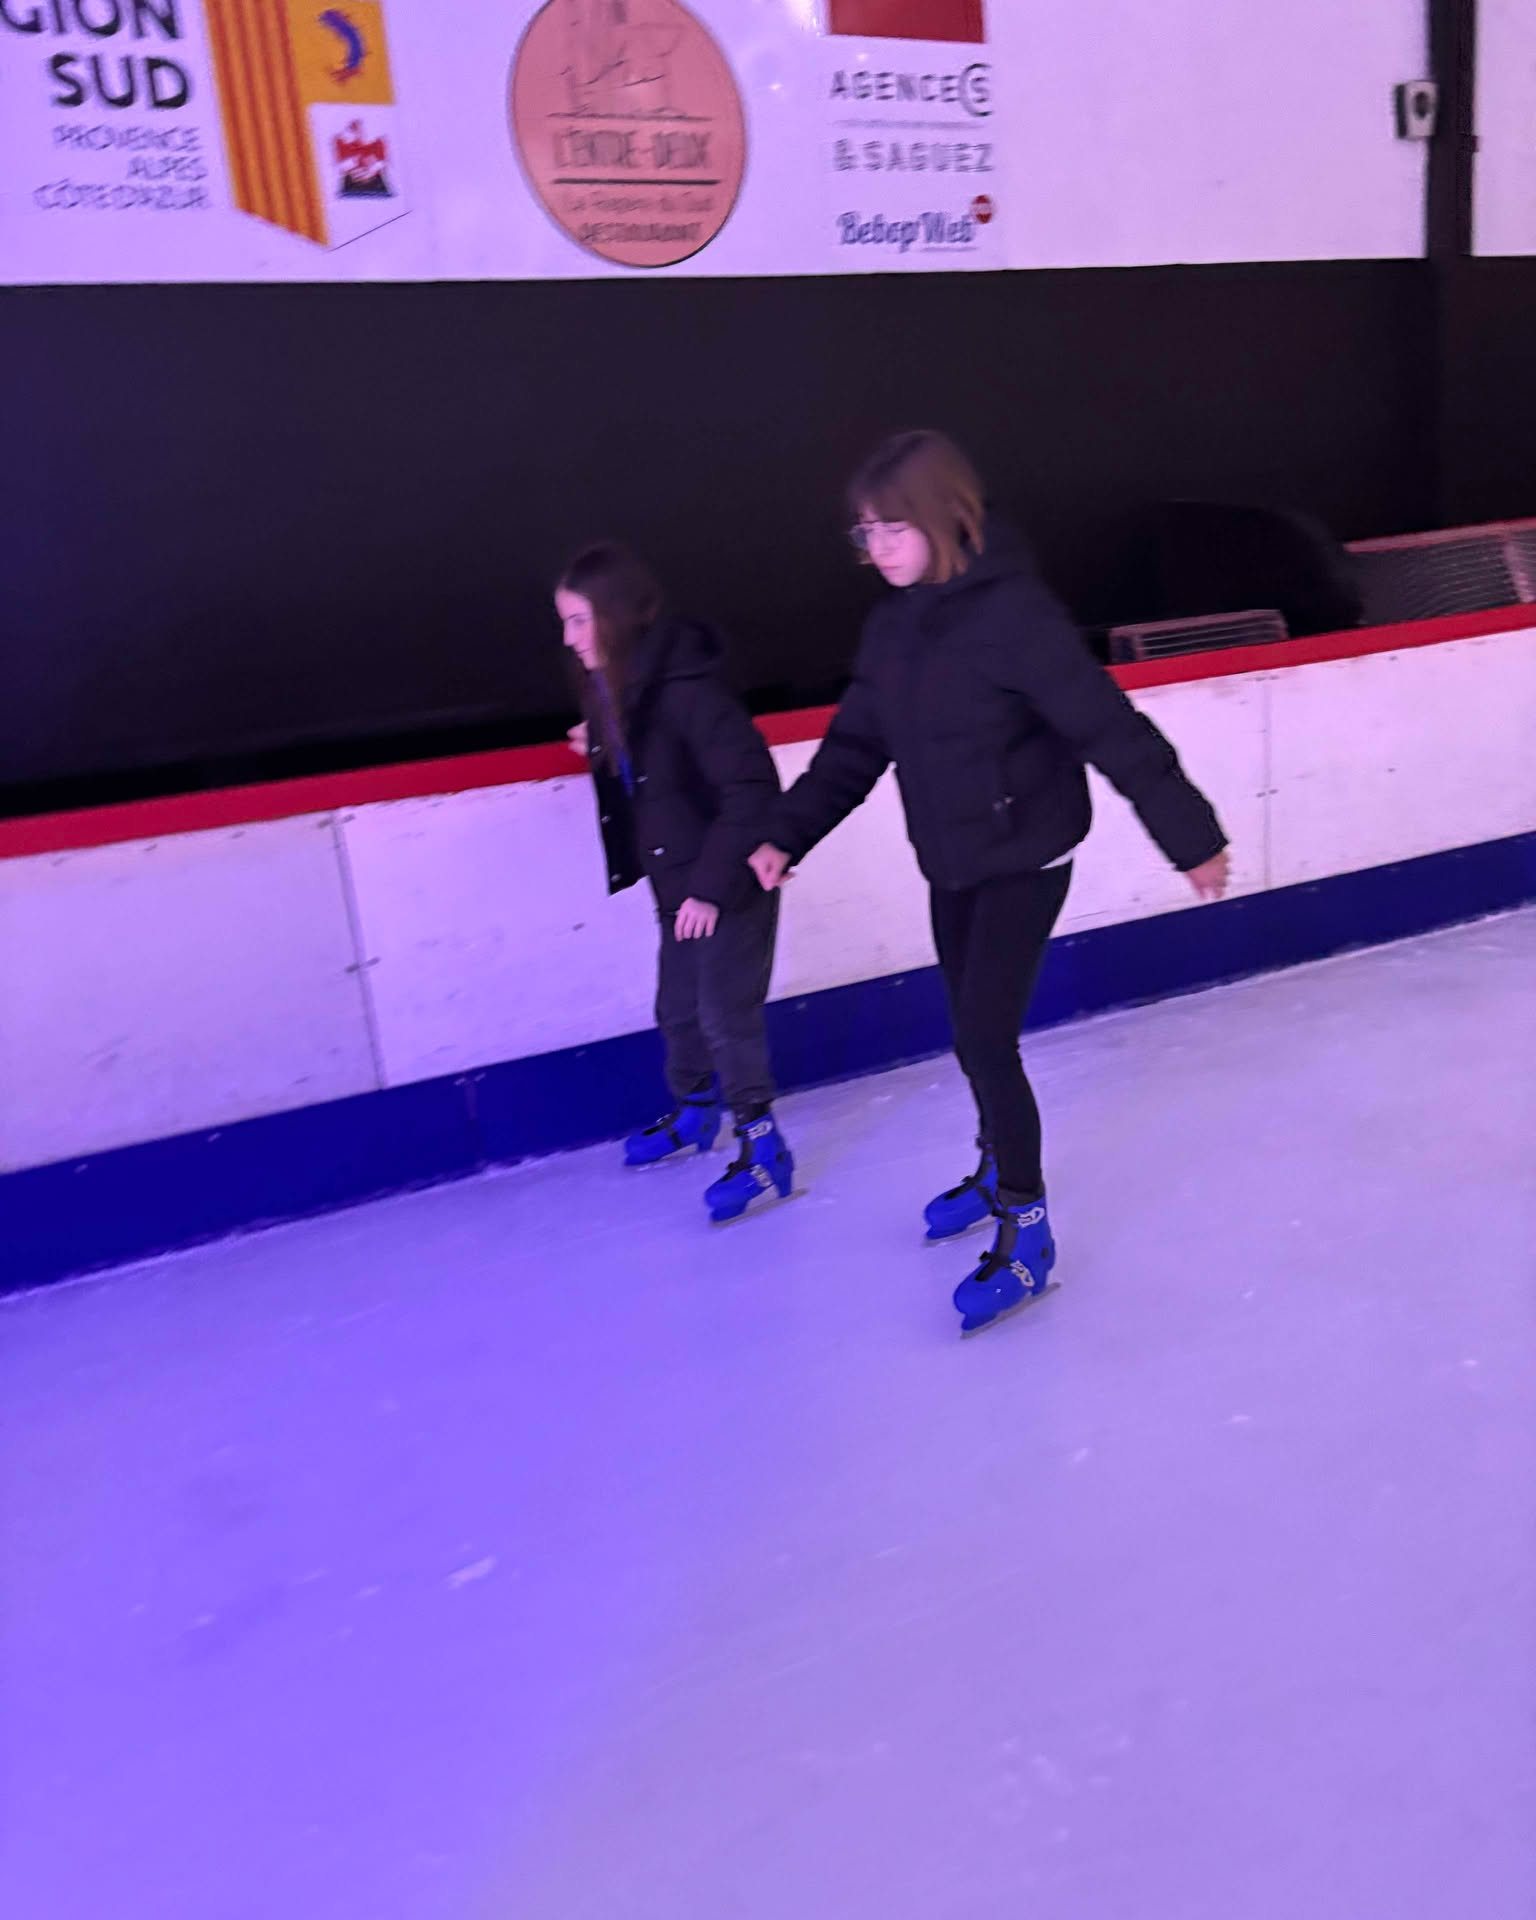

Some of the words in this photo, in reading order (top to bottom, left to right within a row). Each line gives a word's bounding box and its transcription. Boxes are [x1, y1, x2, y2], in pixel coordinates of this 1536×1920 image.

[47, 53, 191, 109] SUD
[53, 124, 202, 151] PROVENCE
[127, 156, 208, 181] ALPES
